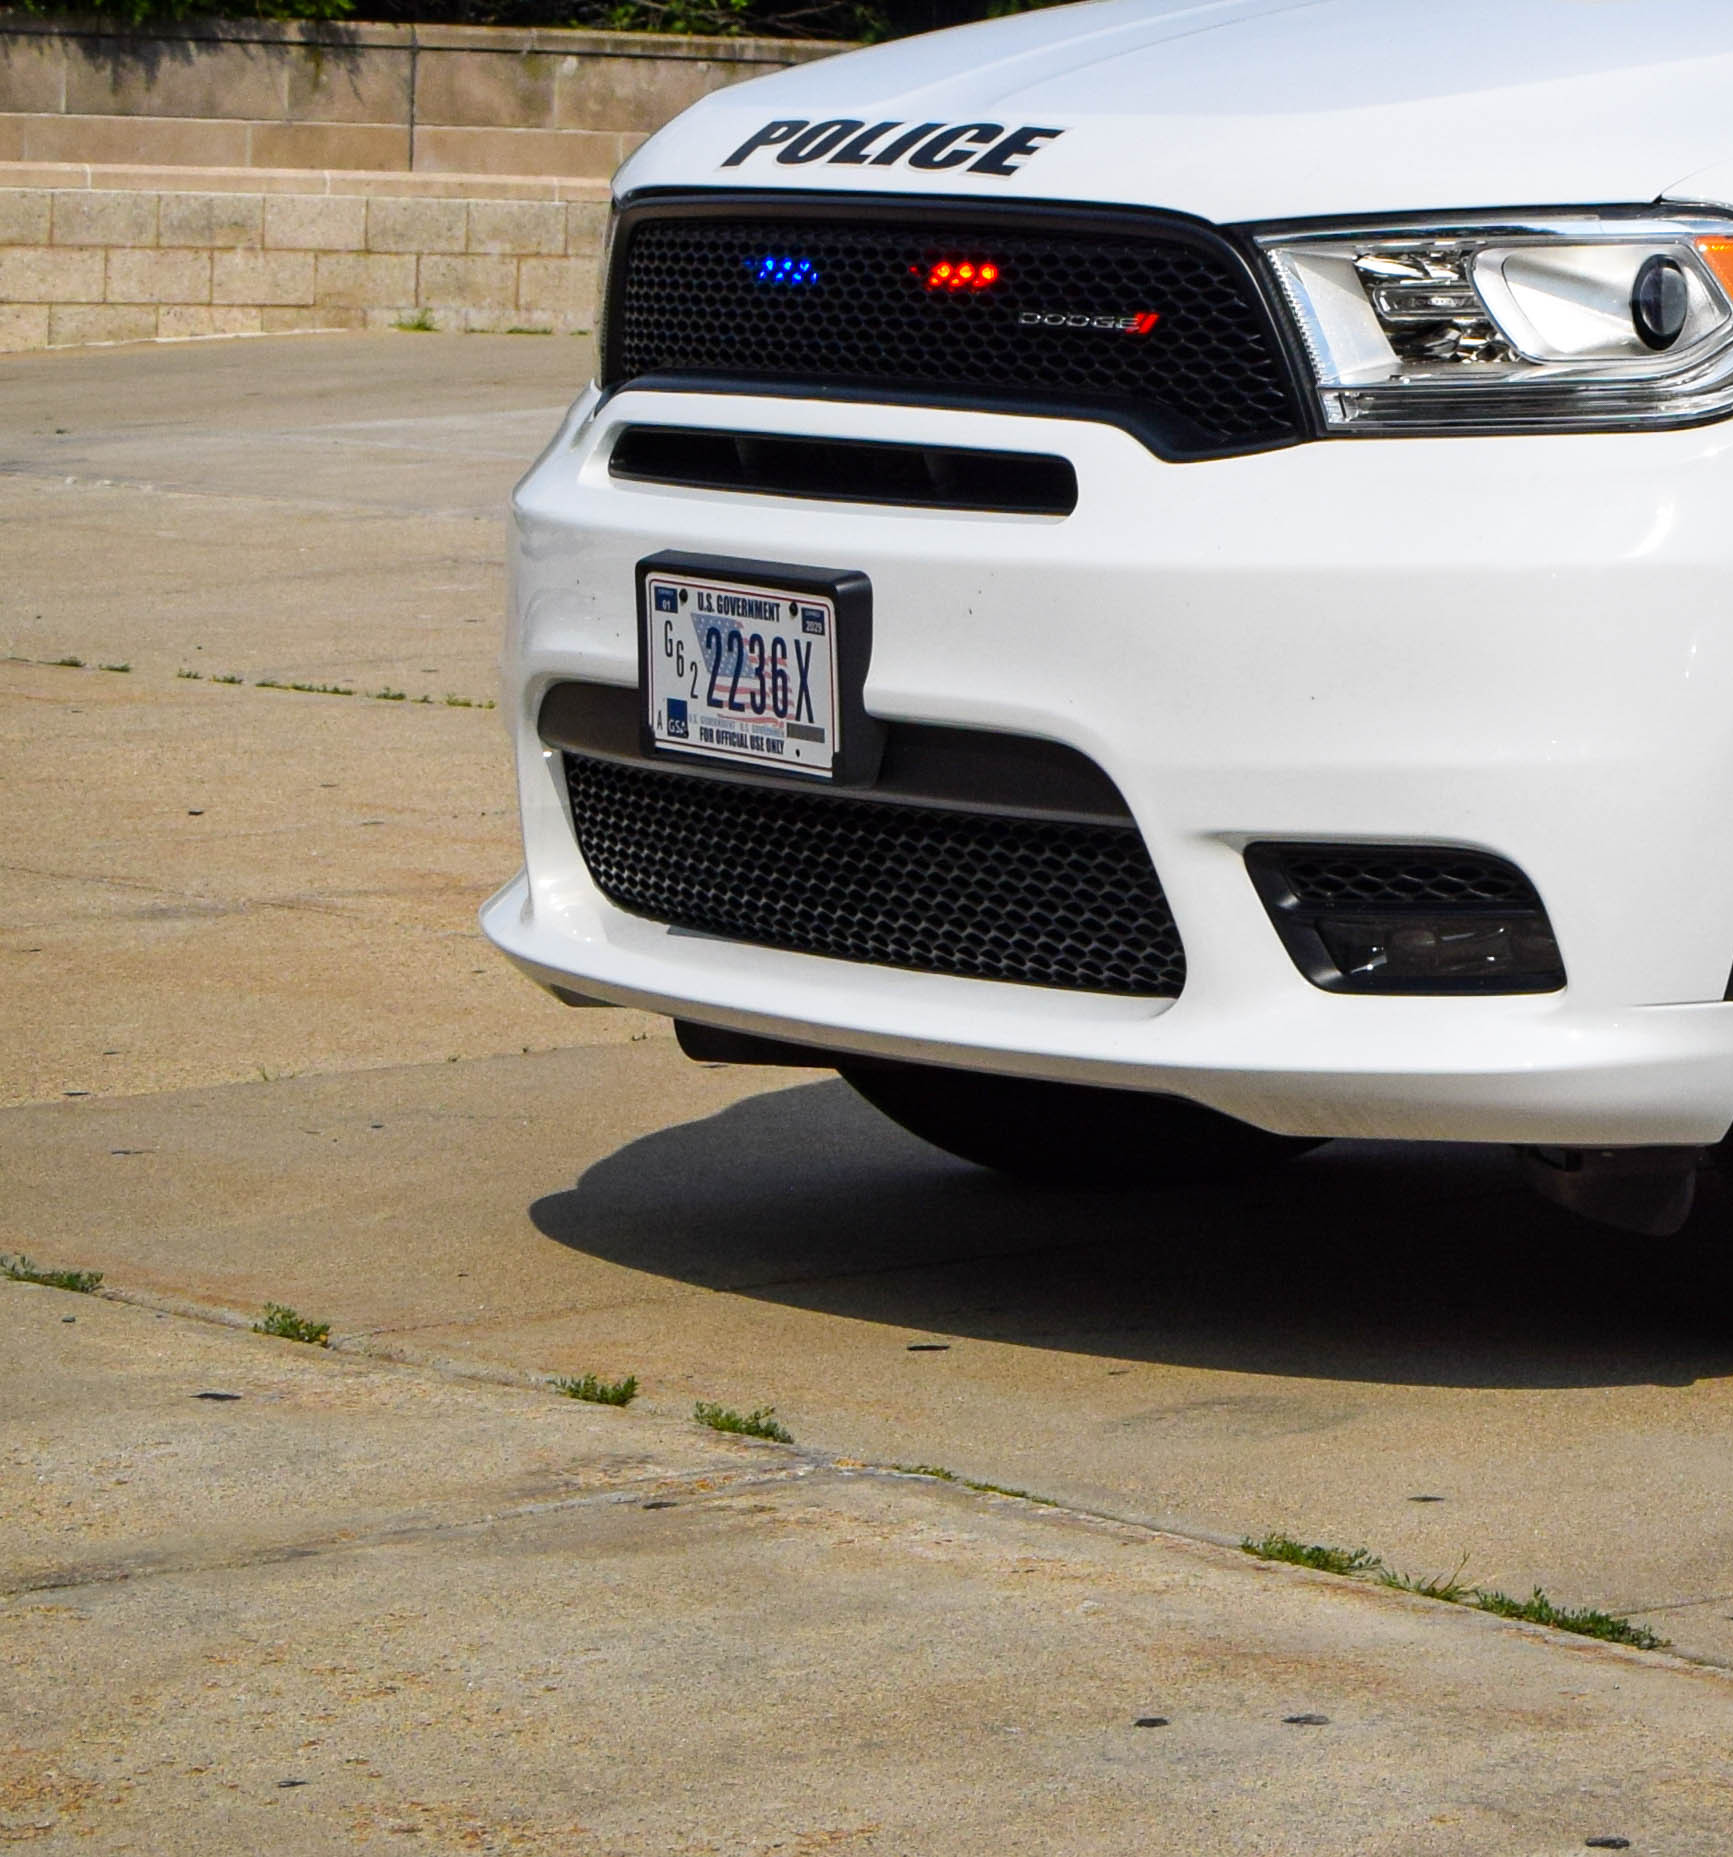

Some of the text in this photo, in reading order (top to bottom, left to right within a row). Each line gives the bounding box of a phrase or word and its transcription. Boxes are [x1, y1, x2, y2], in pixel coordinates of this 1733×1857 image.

[720, 118, 1064, 177] POLICE
[1019, 311, 1140, 331] DODGE
[697, 591, 781, 623] U.S. GOVERNMENT
[706, 626, 815, 724] 2236X
[700, 725, 714, 744] FOR
[716, 728, 748, 750] OFFICIAL
[749, 734, 765, 752] USE
[765, 736, 785, 755] ONLY
